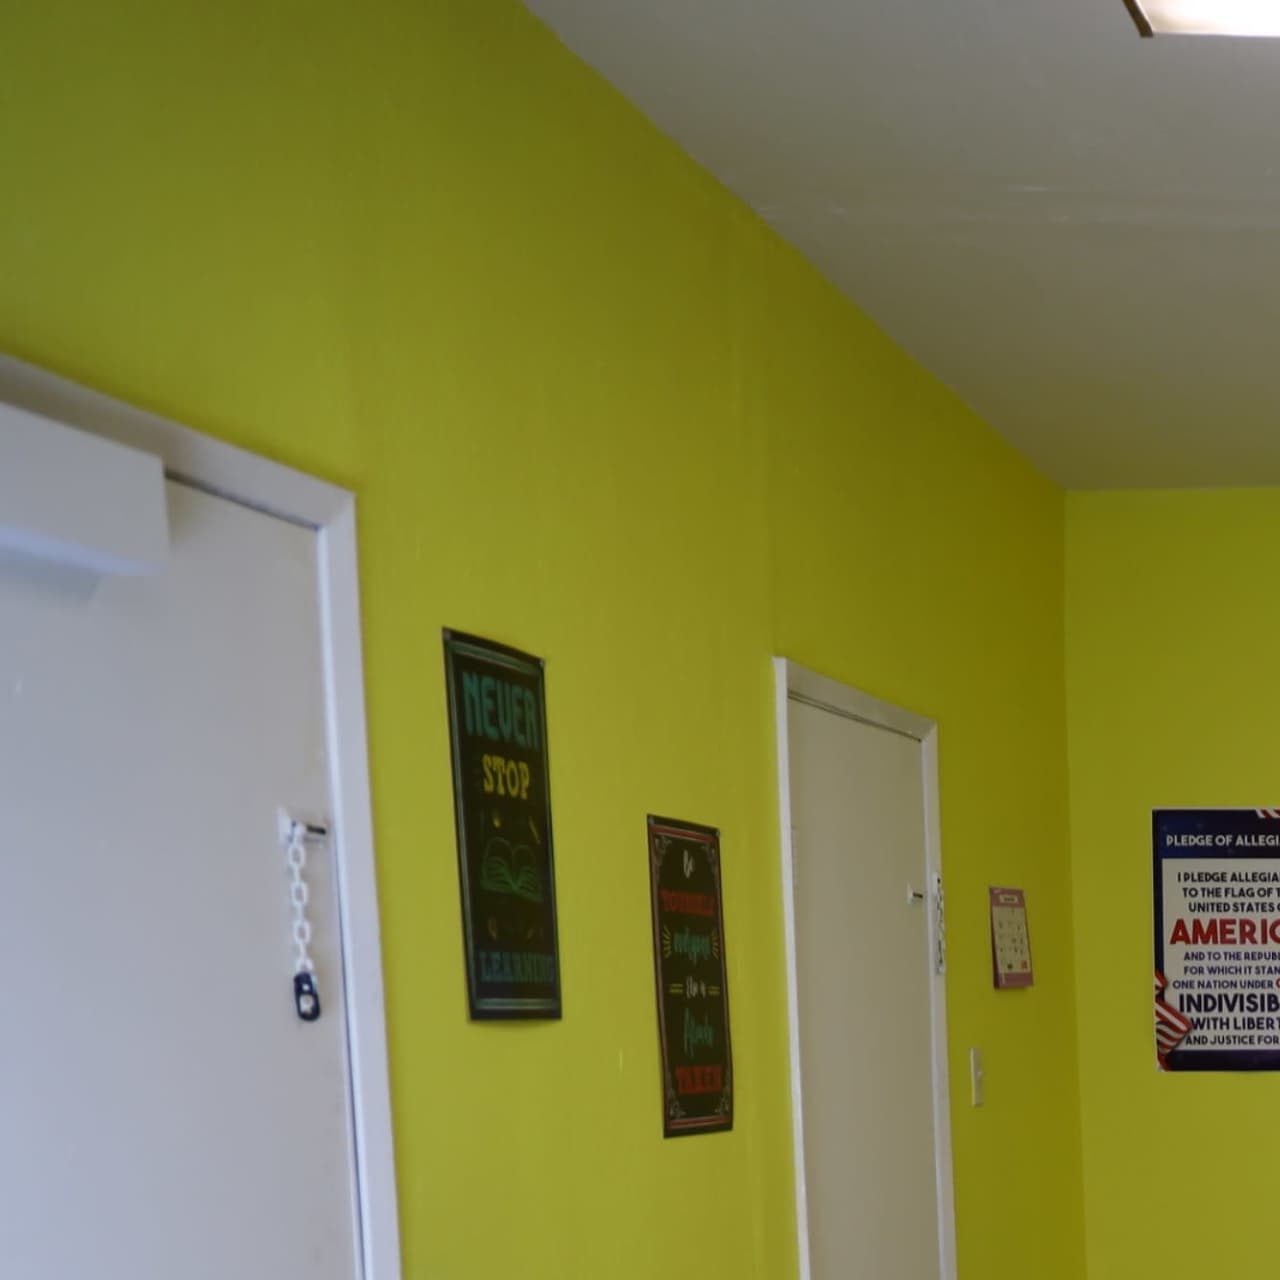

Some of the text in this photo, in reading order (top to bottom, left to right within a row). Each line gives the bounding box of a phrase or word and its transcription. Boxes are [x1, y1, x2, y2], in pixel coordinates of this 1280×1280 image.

[462, 670, 538, 750] NEVER
[482, 754, 531, 800] STOP
[1166, 835, 1213, 846] PLEDGE
[1215, 835, 1233, 846] OF
[1178, 872, 1181, 882] I
[1184, 872, 1227, 882] PLEDGE
[1183, 888, 1198, 898] TO
[1201, 888, 1222, 898] THE
[1225, 888, 1255, 898] FLAG
[1257, 888, 1273, 898] OF
[1188, 902, 1230, 912] UNITED
[1233, 902, 1274, 912] STATES
[1184, 952, 1205, 961] AND
[1208, 952, 1222, 961] TO
[1224, 952, 1241, 961] THE
[479, 950, 557, 983] LEARNING
[1184, 966, 1204, 975] FOR
[1207, 966, 1242, 975] WHICH
[1244, 966, 1252, 975] IT
[1172, 980, 1195, 989] ONE
[1197, 980, 1238, 989] NATION
[1240, 980, 1274, 989] UNDER
[1190, 1017, 1230, 1030] WITH
[1186, 1035, 1208, 1045] AND
[1210, 1035, 1256, 1045] JUSTICE
[1258, 1035, 1279, 1045] FOR
